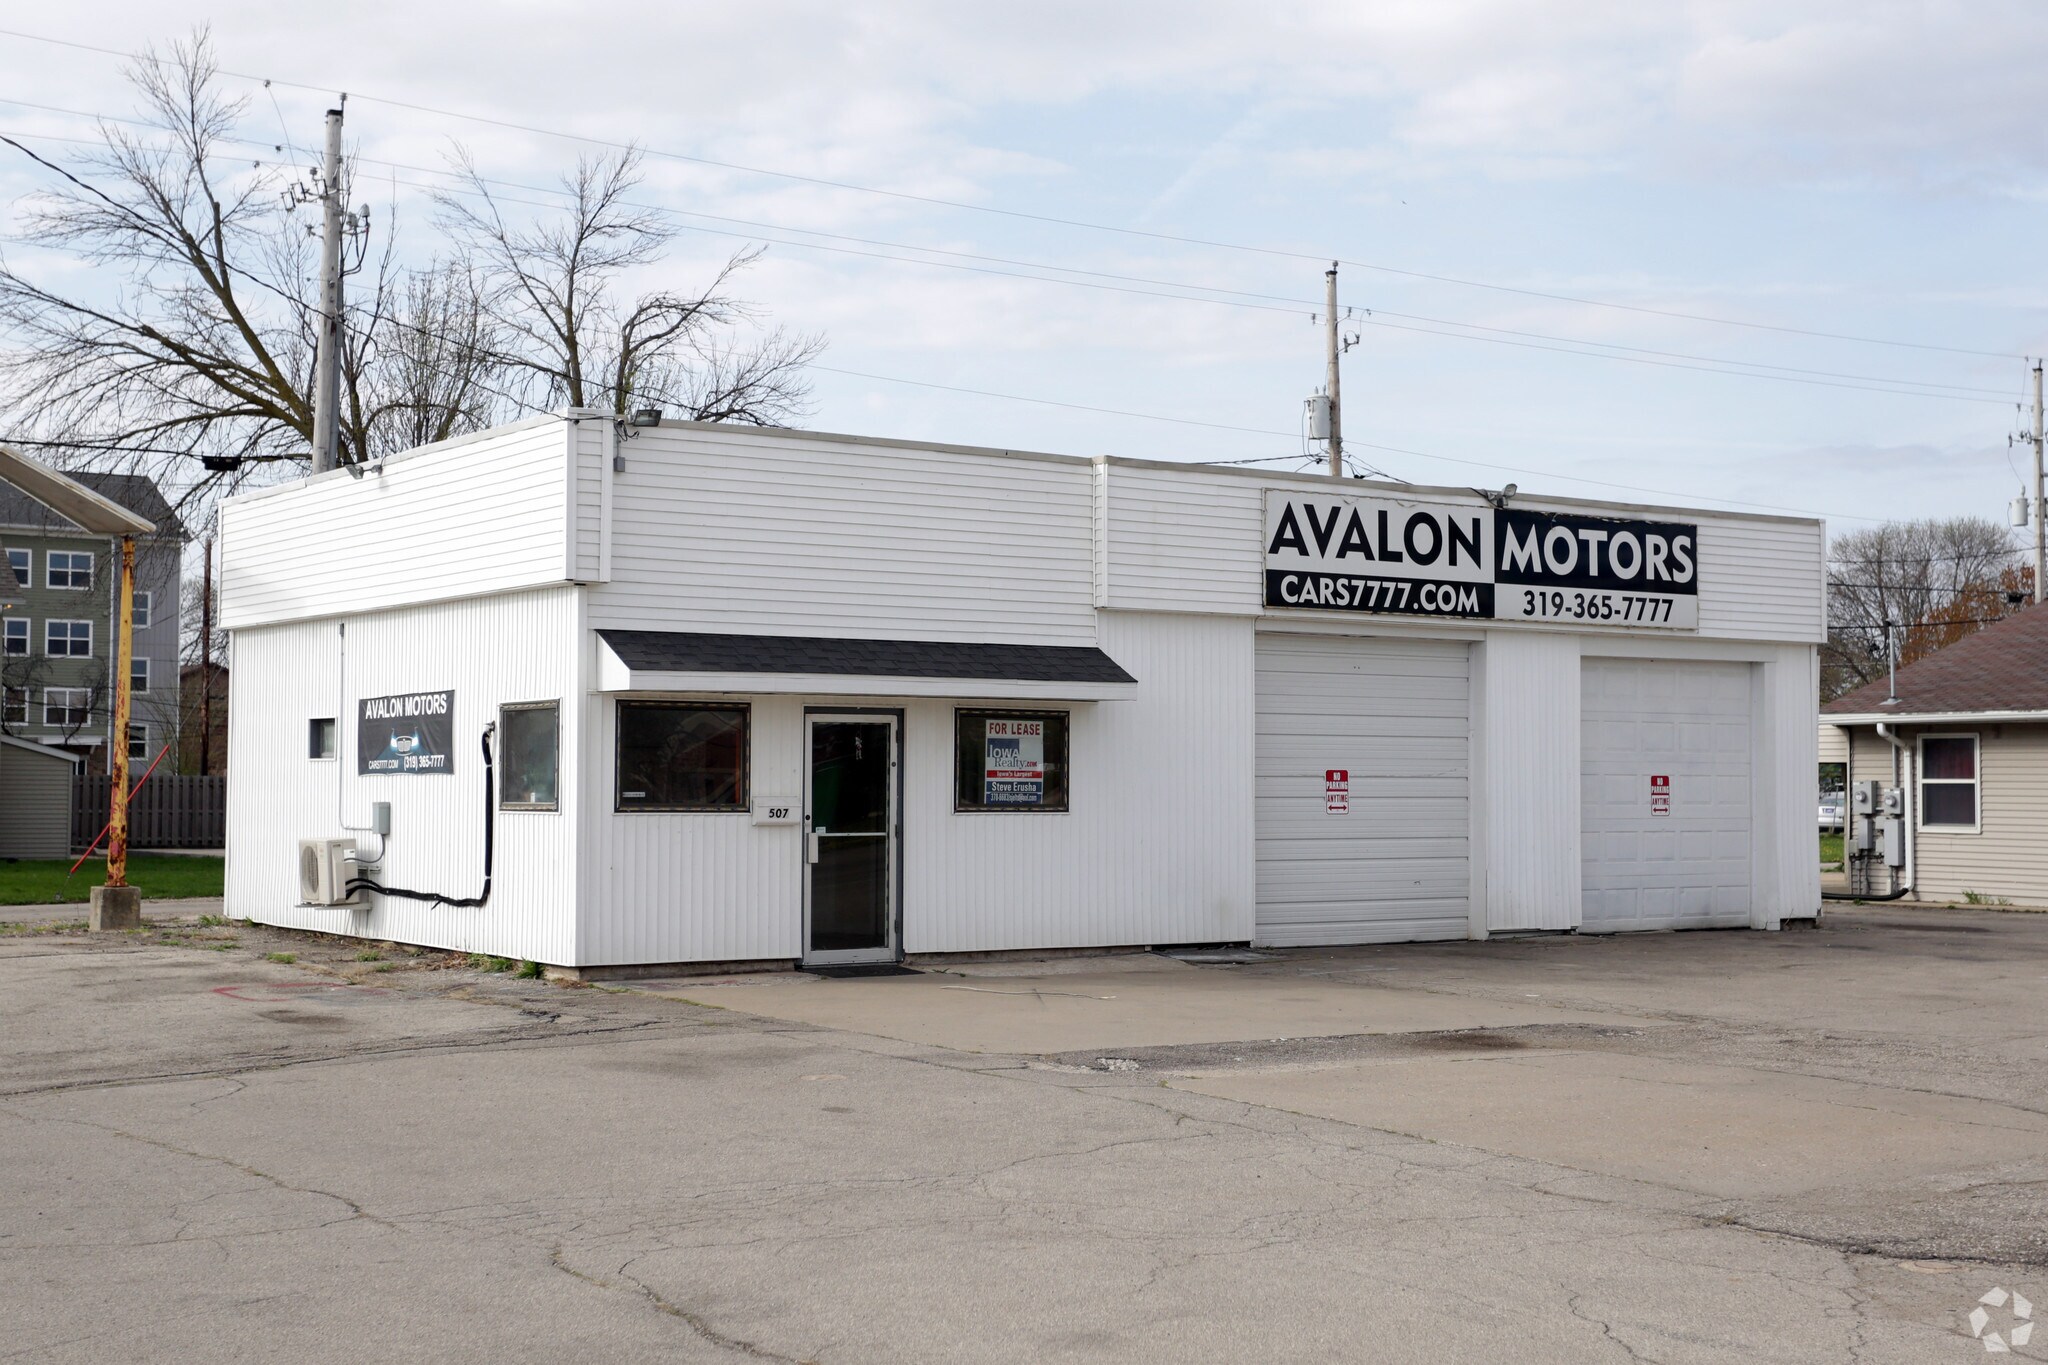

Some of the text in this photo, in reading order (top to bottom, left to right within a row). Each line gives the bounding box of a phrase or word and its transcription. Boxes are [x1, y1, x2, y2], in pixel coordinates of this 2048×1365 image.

[1268, 501, 1694, 583] AVALON MOTORS
[1280, 574, 1480, 613] CARS7777.COM
[1523, 590, 1674, 622] 319-365-7777
[365, 694, 447, 719] AVALON MOTORS
[989, 722, 1040, 735] FOR LEASE
[404, 755, 419, 771] (319)
[419, 755, 445, 768] 365-7777
[1333, 772, 1341, 780] NO
[1656, 777, 1663, 785] NO
[991, 781, 1037, 792] Steve Erusha
[1326, 781, 1348, 789] PARKING
[1327, 794, 1348, 802] ANYTIME
[769, 808, 789, 818] 507
